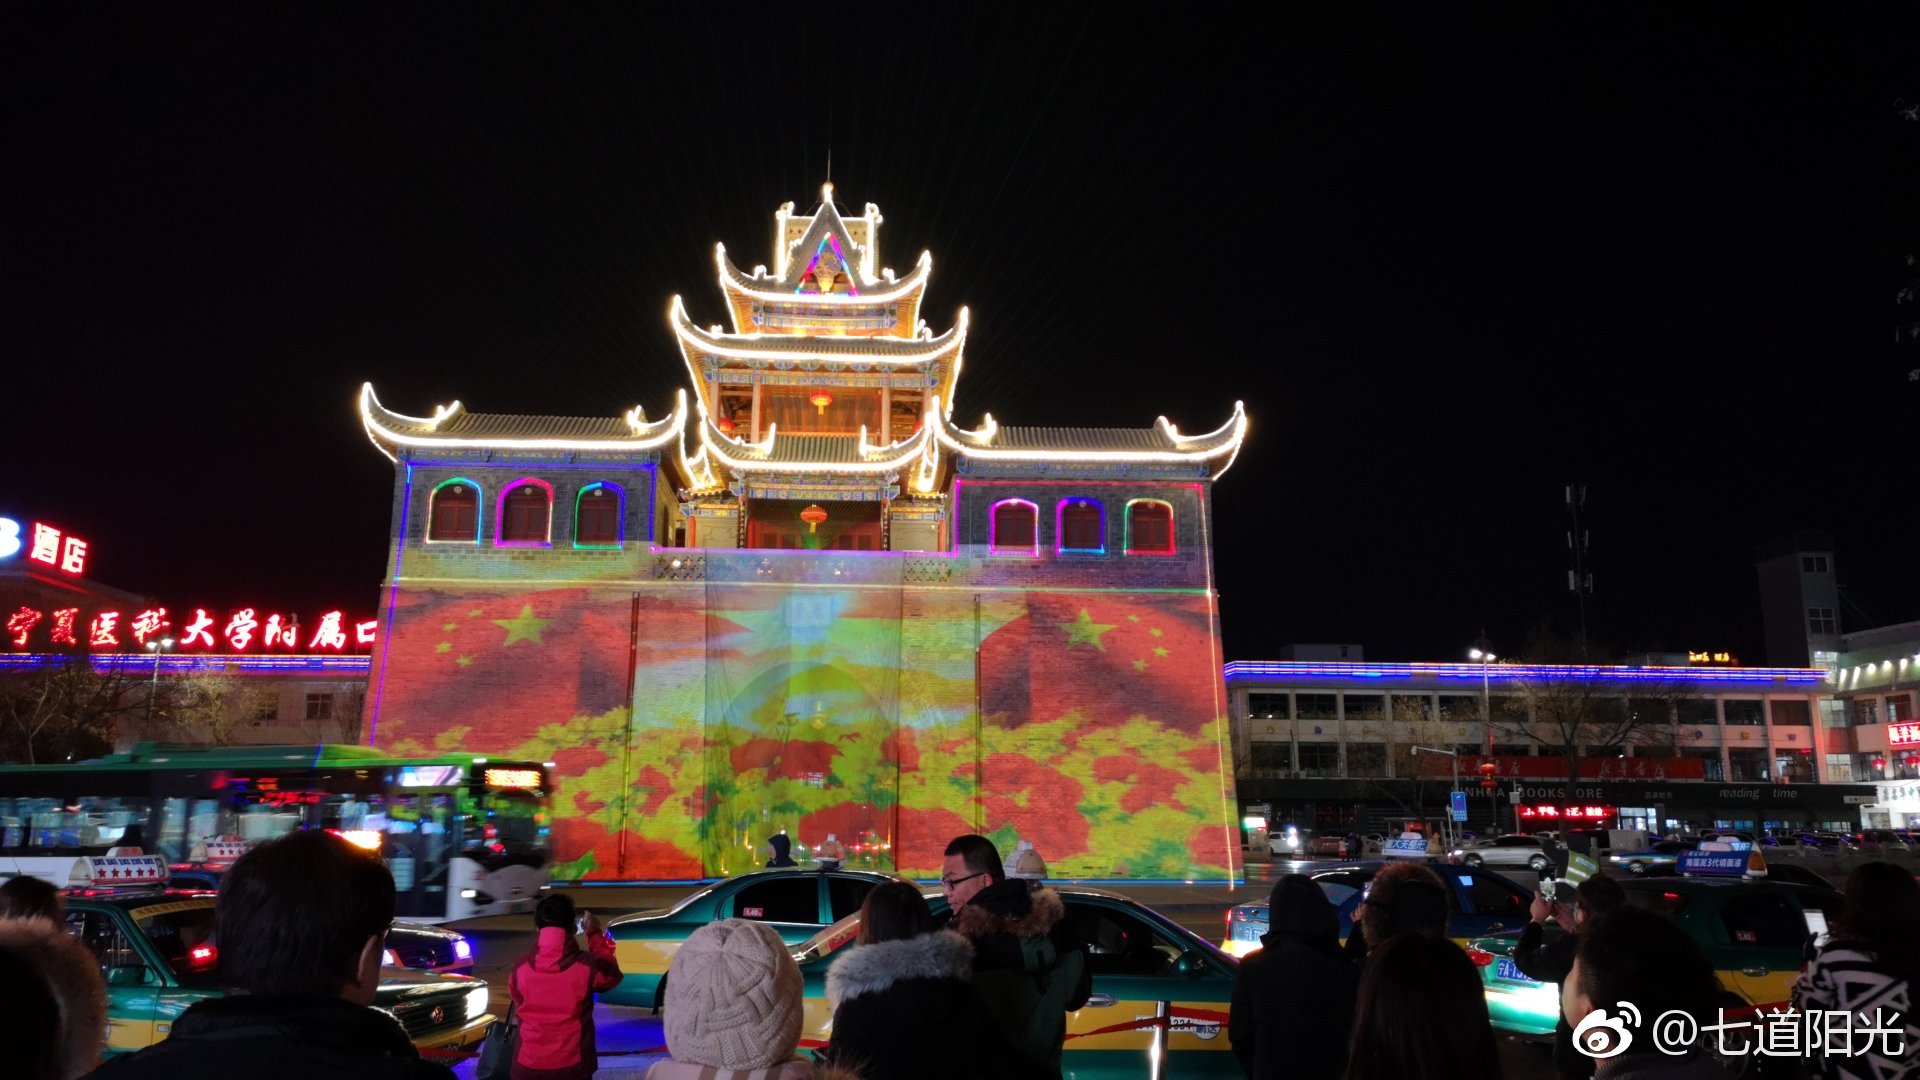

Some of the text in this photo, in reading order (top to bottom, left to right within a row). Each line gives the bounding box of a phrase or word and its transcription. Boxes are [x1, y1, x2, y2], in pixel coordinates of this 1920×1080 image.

[31, 522, 87, 574] 酒店
[1518, 787, 1604, 799] BOOKSORE
[1719, 788, 1798, 800] reading time
